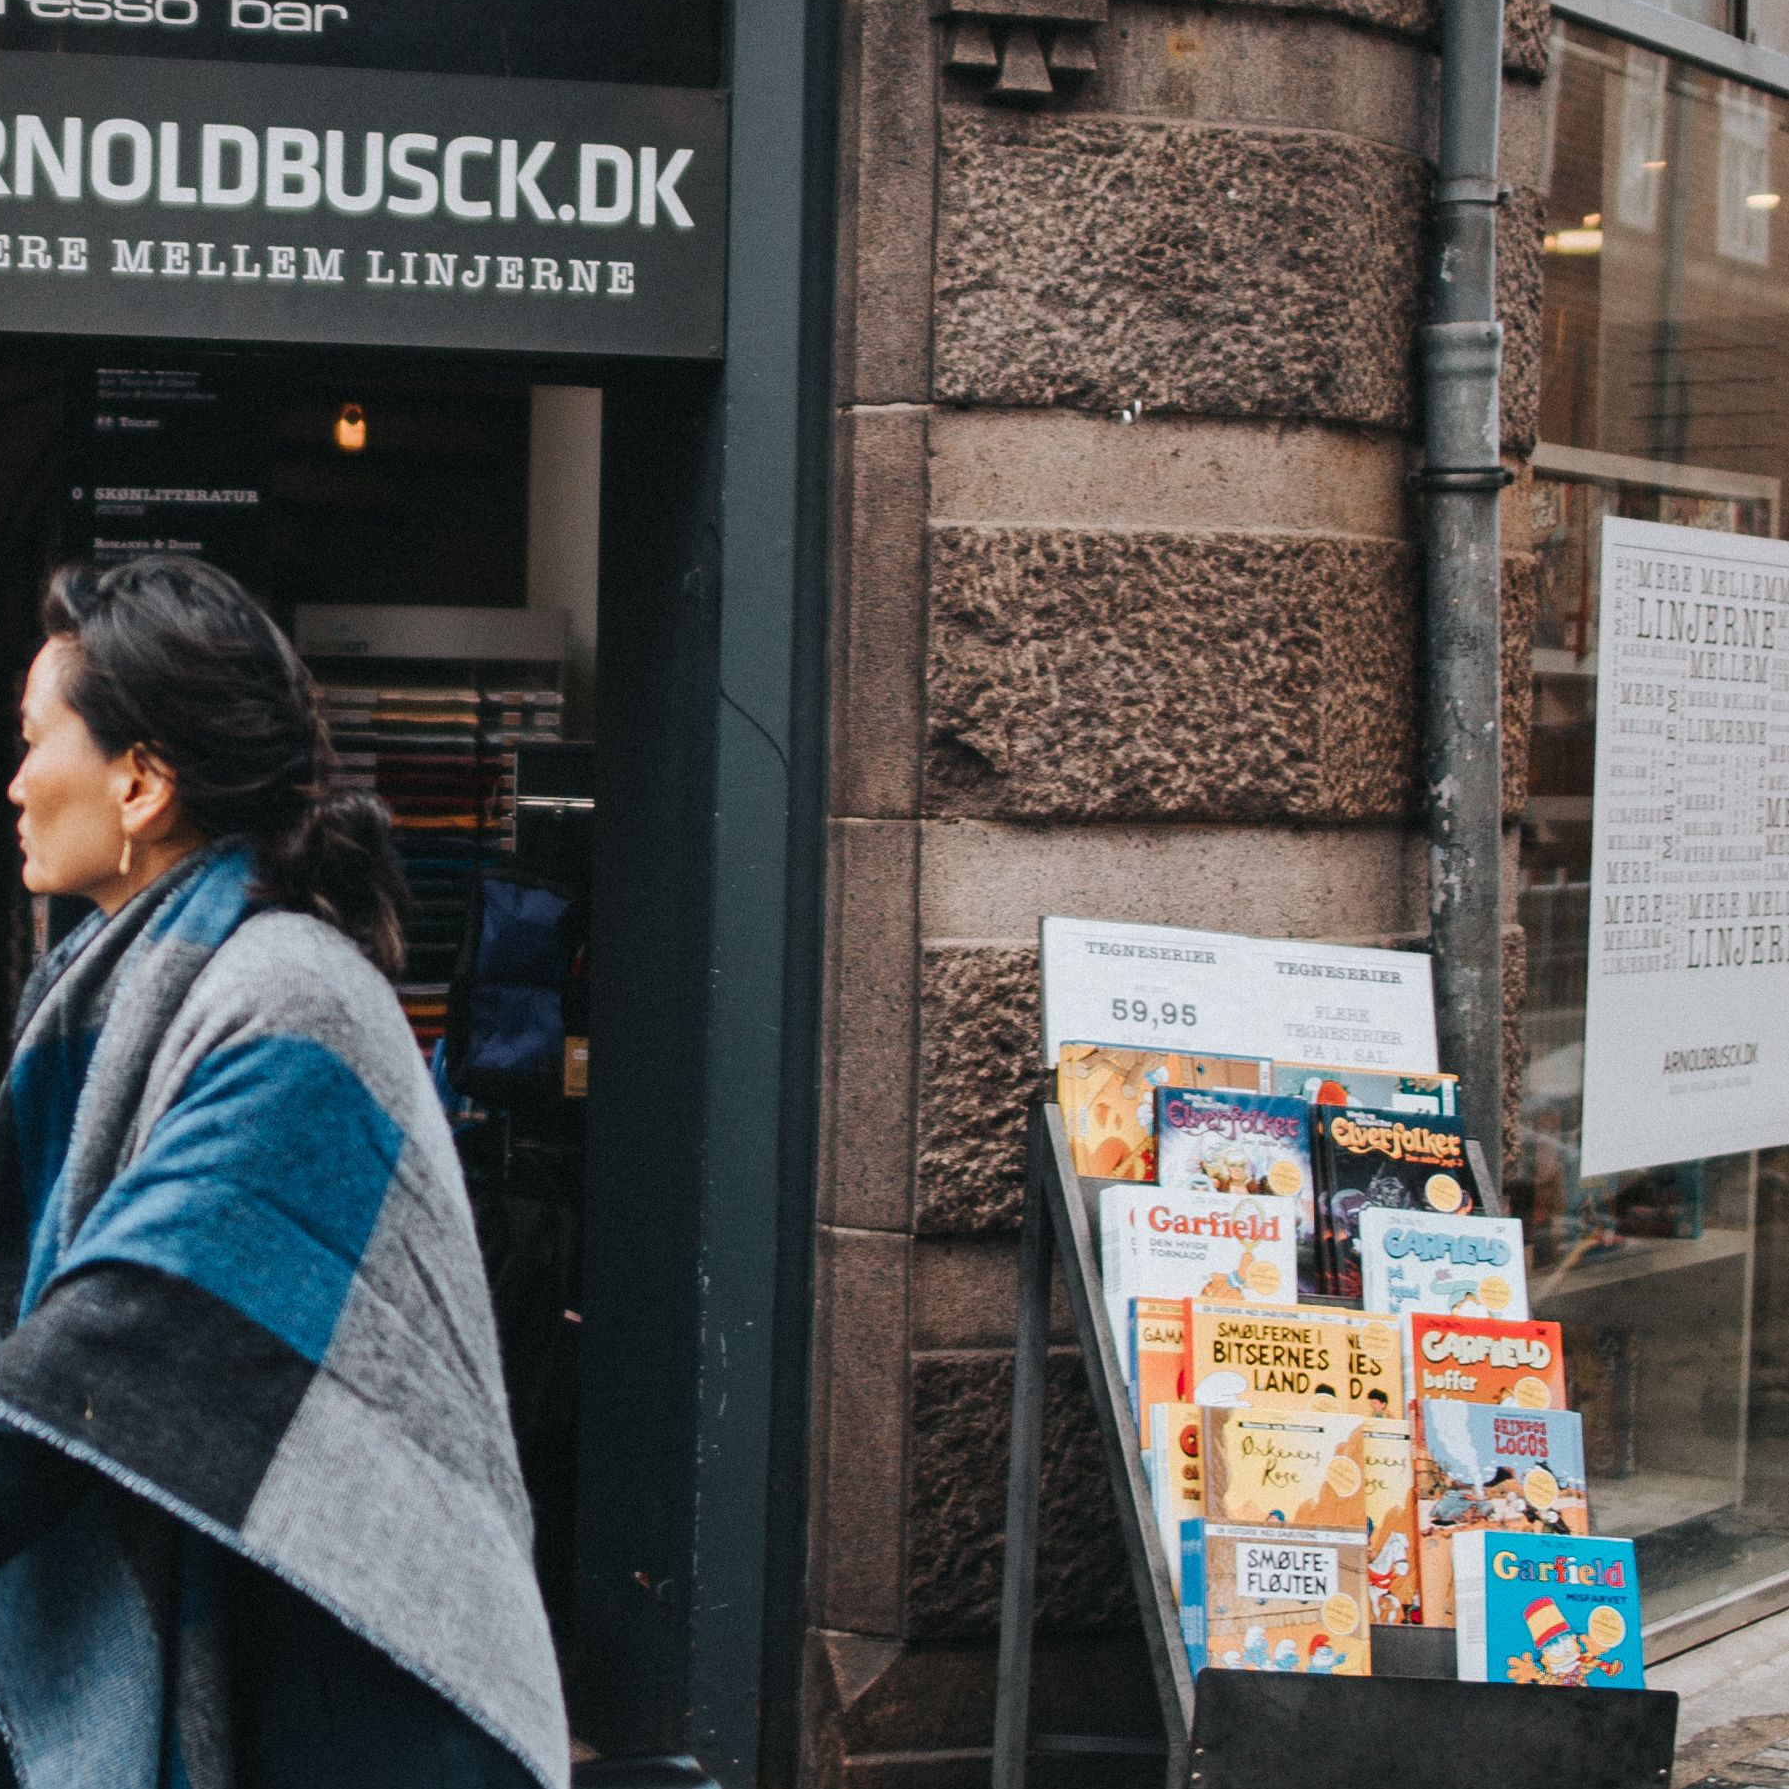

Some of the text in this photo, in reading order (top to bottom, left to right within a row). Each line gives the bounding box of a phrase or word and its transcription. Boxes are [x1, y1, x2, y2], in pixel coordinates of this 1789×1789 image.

[111, 237, 346, 283] MELLEM
[366, 249, 637, 295] LINJERNE
[1637, 559, 1693, 594] MERE
[1637, 596, 1774, 650] LINJERNE
[1690, 649, 1769, 684] MELLEM
[1686, 717, 1768, 746] LINJERNE
[1604, 893, 1663, 925] MERE
[1687, 892, 1740, 920] MERE
[1085, 941, 1217, 965] TEGNESERIER
[1275, 961, 1403, 985] TEGNESERIER
[1111, 998, 1199, 1030] 59,95
[1284, 1023, 1404, 1047] TEGNESERIER
[1354, 1046, 1390, 1065] SAL
[1662, 1042, 1759, 1076] ARNOLDBUSCK.DK
[1330, 1116, 1462, 1160] Elverfolket
[1148, 1205, 1281, 1242] Garfield
[1149, 1237, 1175, 1248] DEN
[1149, 1248, 1207, 1261] TORNADO
[1383, 1227, 1512, 1266] GARFIELD
[1218, 1322, 1311, 1344] SMØLFERNE
[1213, 1340, 1330, 1372] BITSERNES
[1421, 1330, 1552, 1370] GARFIELD
[1254, 1369, 1310, 1394] LAND
[1494, 1433, 1549, 1458] LOCOS
[1247, 1549, 1329, 1572] SMØLFE-
[1492, 1551, 1627, 1589] Garfield
[1247, 1571, 1328, 1597] FLØJTEN
[1565, 1593, 1628, 1606] MISFARVET
